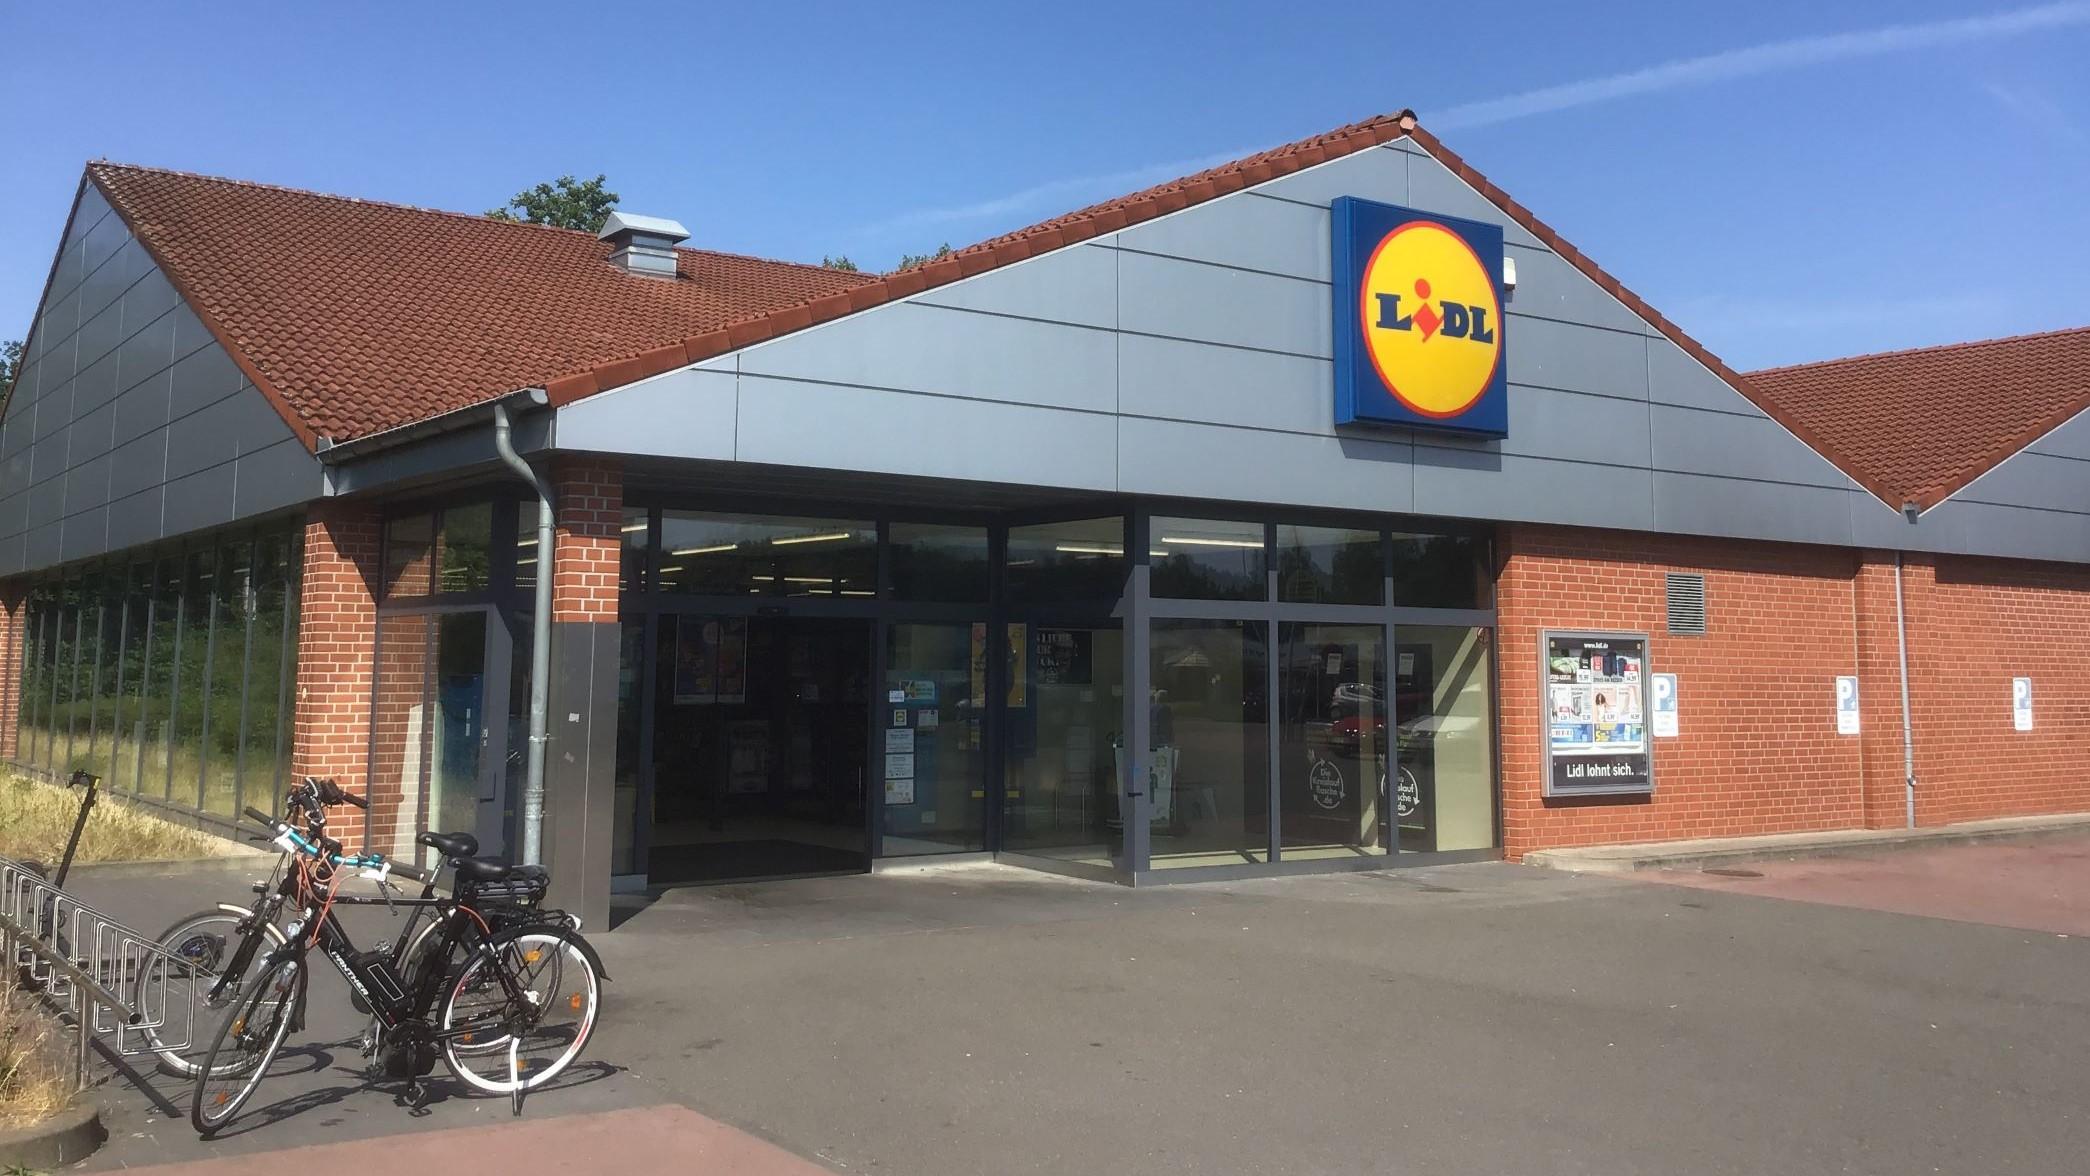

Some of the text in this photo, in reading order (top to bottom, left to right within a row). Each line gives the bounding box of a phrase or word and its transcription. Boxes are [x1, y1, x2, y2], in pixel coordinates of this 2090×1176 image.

[1567, 762, 1634, 778] Lidl lohnt sich.
[331, 951, 369, 995] PANTHER
